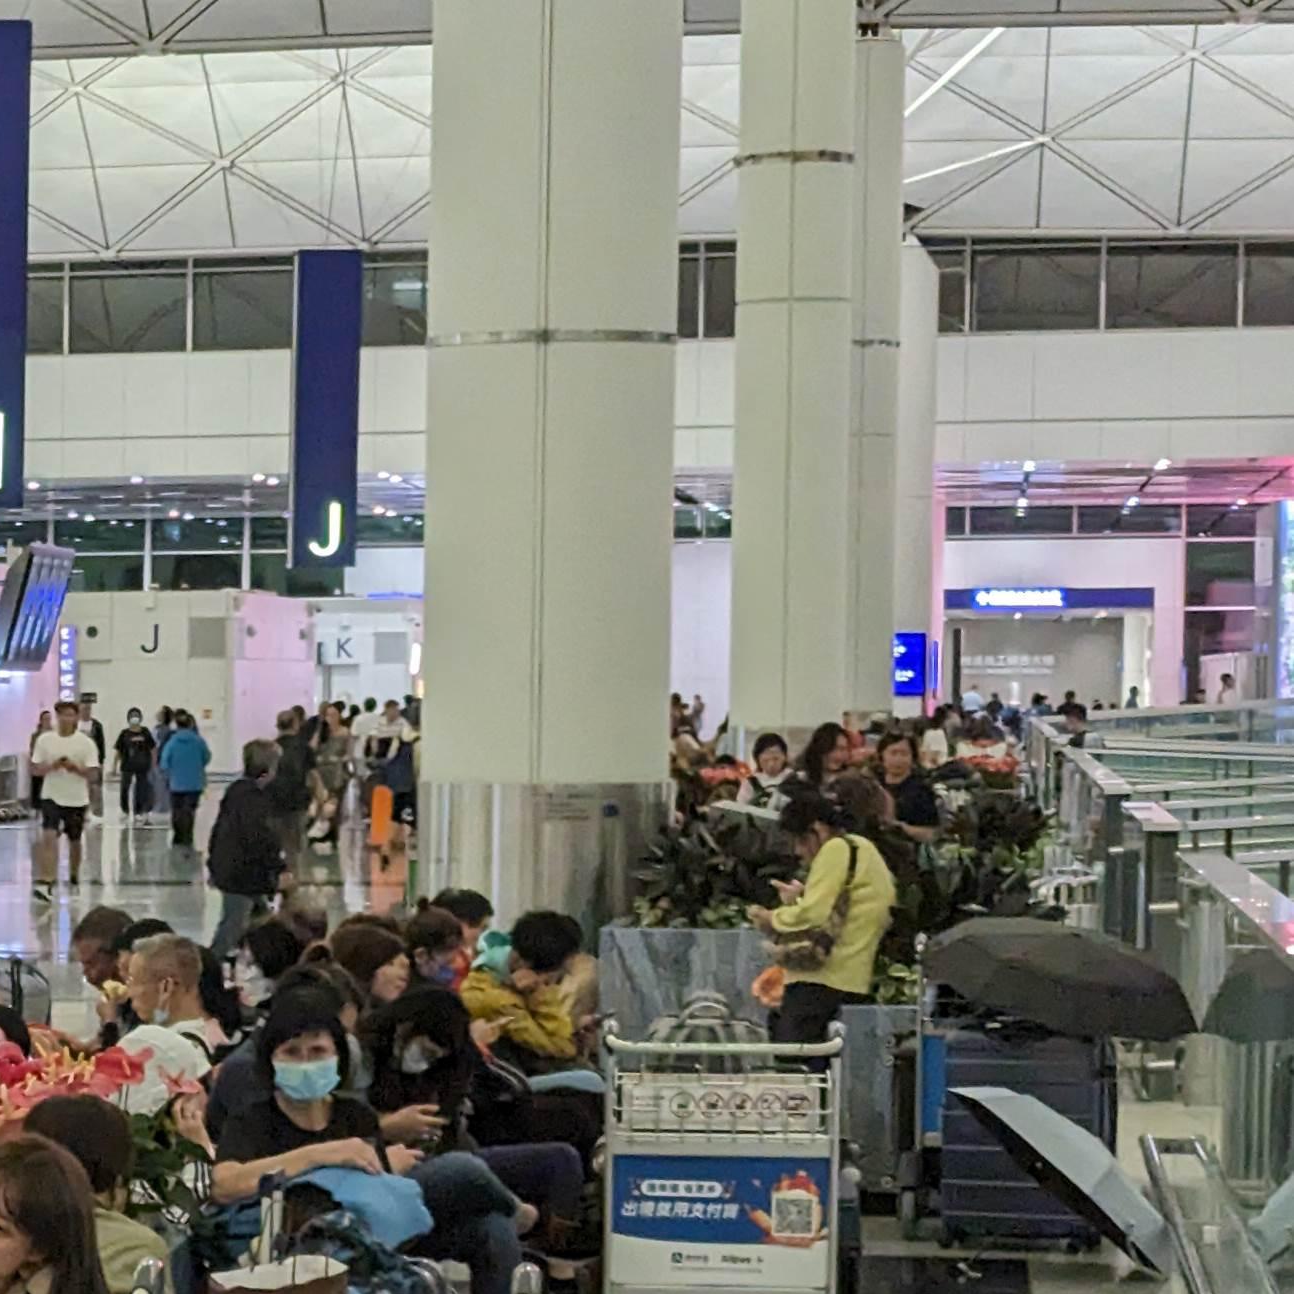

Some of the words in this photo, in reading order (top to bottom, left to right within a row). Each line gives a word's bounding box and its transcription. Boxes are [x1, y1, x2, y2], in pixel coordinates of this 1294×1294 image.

[308, 502, 343, 557] J
[140, 623, 160, 654] J
[336, 637, 353, 659] K
